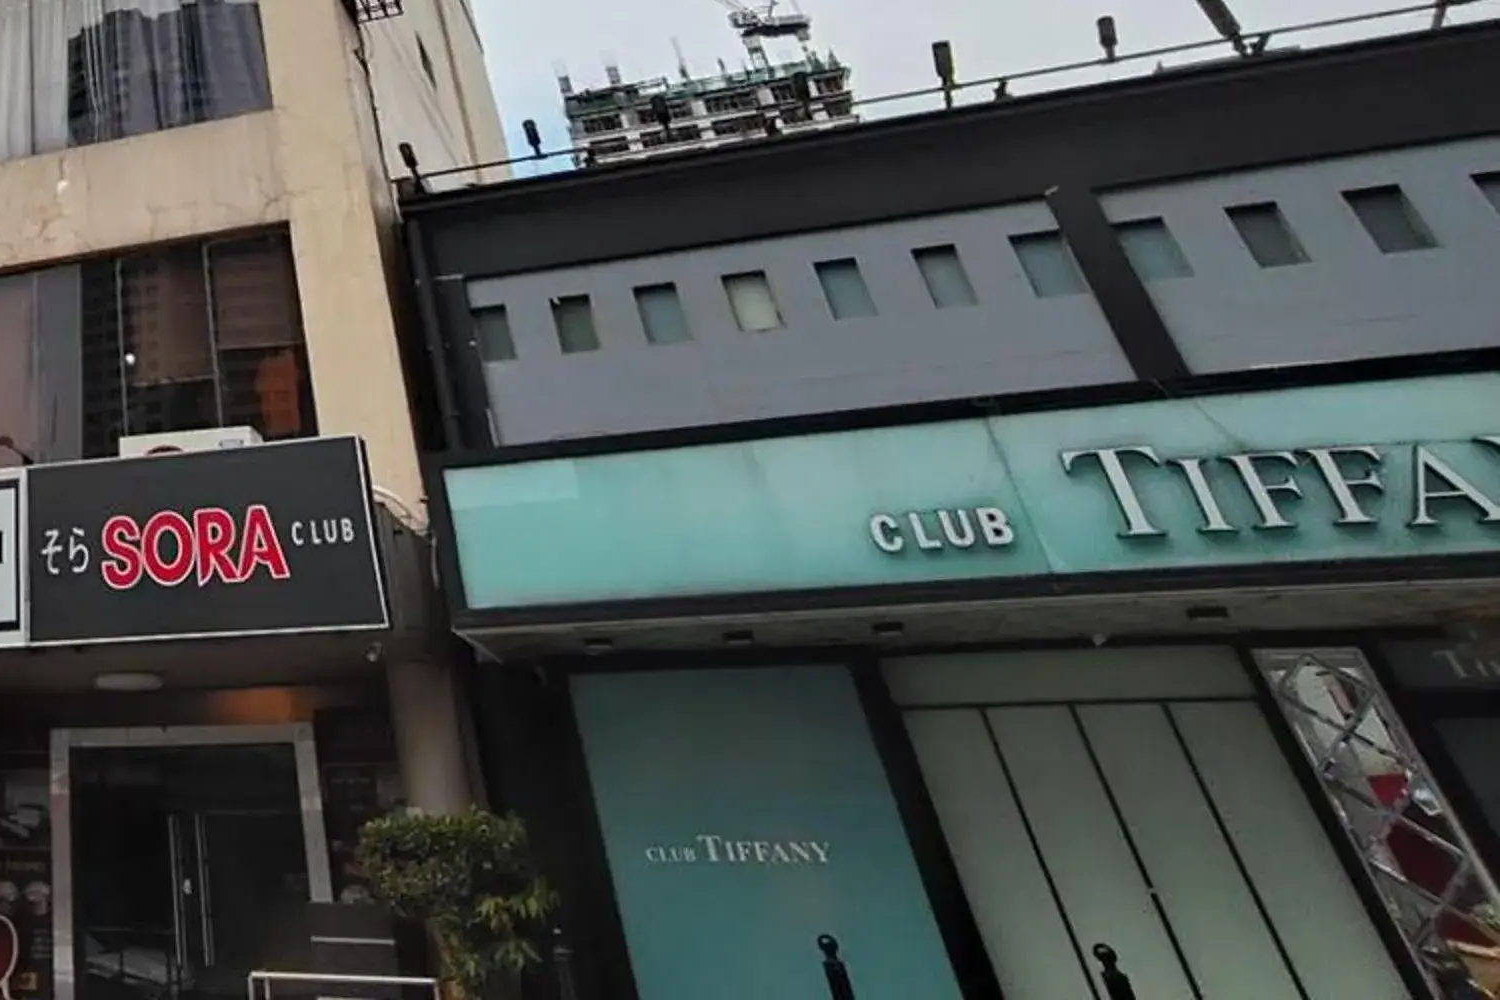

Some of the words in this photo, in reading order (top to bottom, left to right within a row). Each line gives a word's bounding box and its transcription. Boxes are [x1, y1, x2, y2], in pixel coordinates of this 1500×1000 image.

[41, 527, 90, 575] そら
[101, 504, 291, 589] SORA
[291, 517, 356, 546] CLUB
[869, 506, 1015, 553] CLUB
[645, 846, 696, 863] CLUB
[695, 834, 830, 863] TIFFANY
